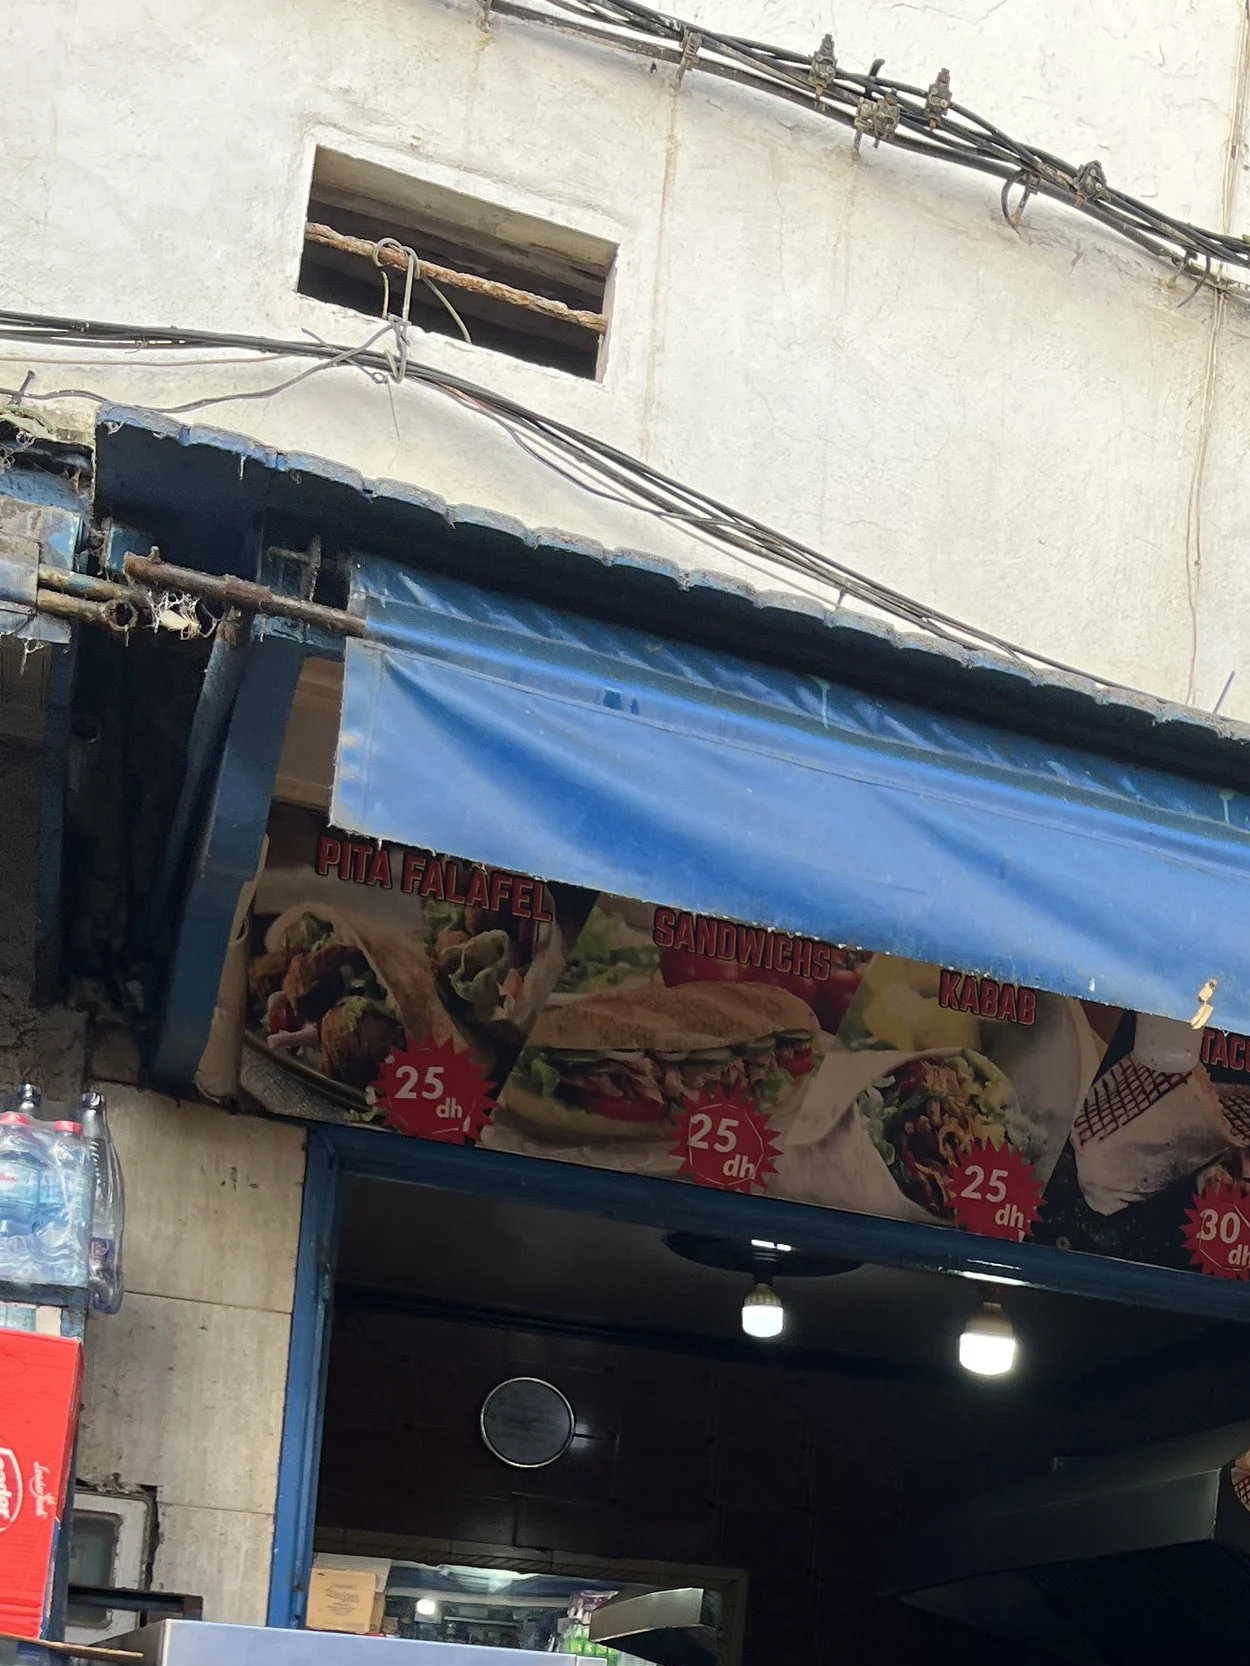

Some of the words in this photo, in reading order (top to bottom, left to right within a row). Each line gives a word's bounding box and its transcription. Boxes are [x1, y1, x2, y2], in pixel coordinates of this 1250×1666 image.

[316, 835, 392, 889] PITA
[402, 852, 552, 922] FALAFEL
[654, 906, 832, 982] SANDWICHS
[939, 969, 1036, 1026] KABAB
[393, 1065, 445, 1100] 25
[435, 1097, 463, 1119] dh
[688, 1113, 740, 1153] 25
[722, 1153, 756, 1180] dh
[960, 1165, 1009, 1203] 25
[994, 1203, 1025, 1229] dh
[1196, 1208, 1241, 1244] 30
